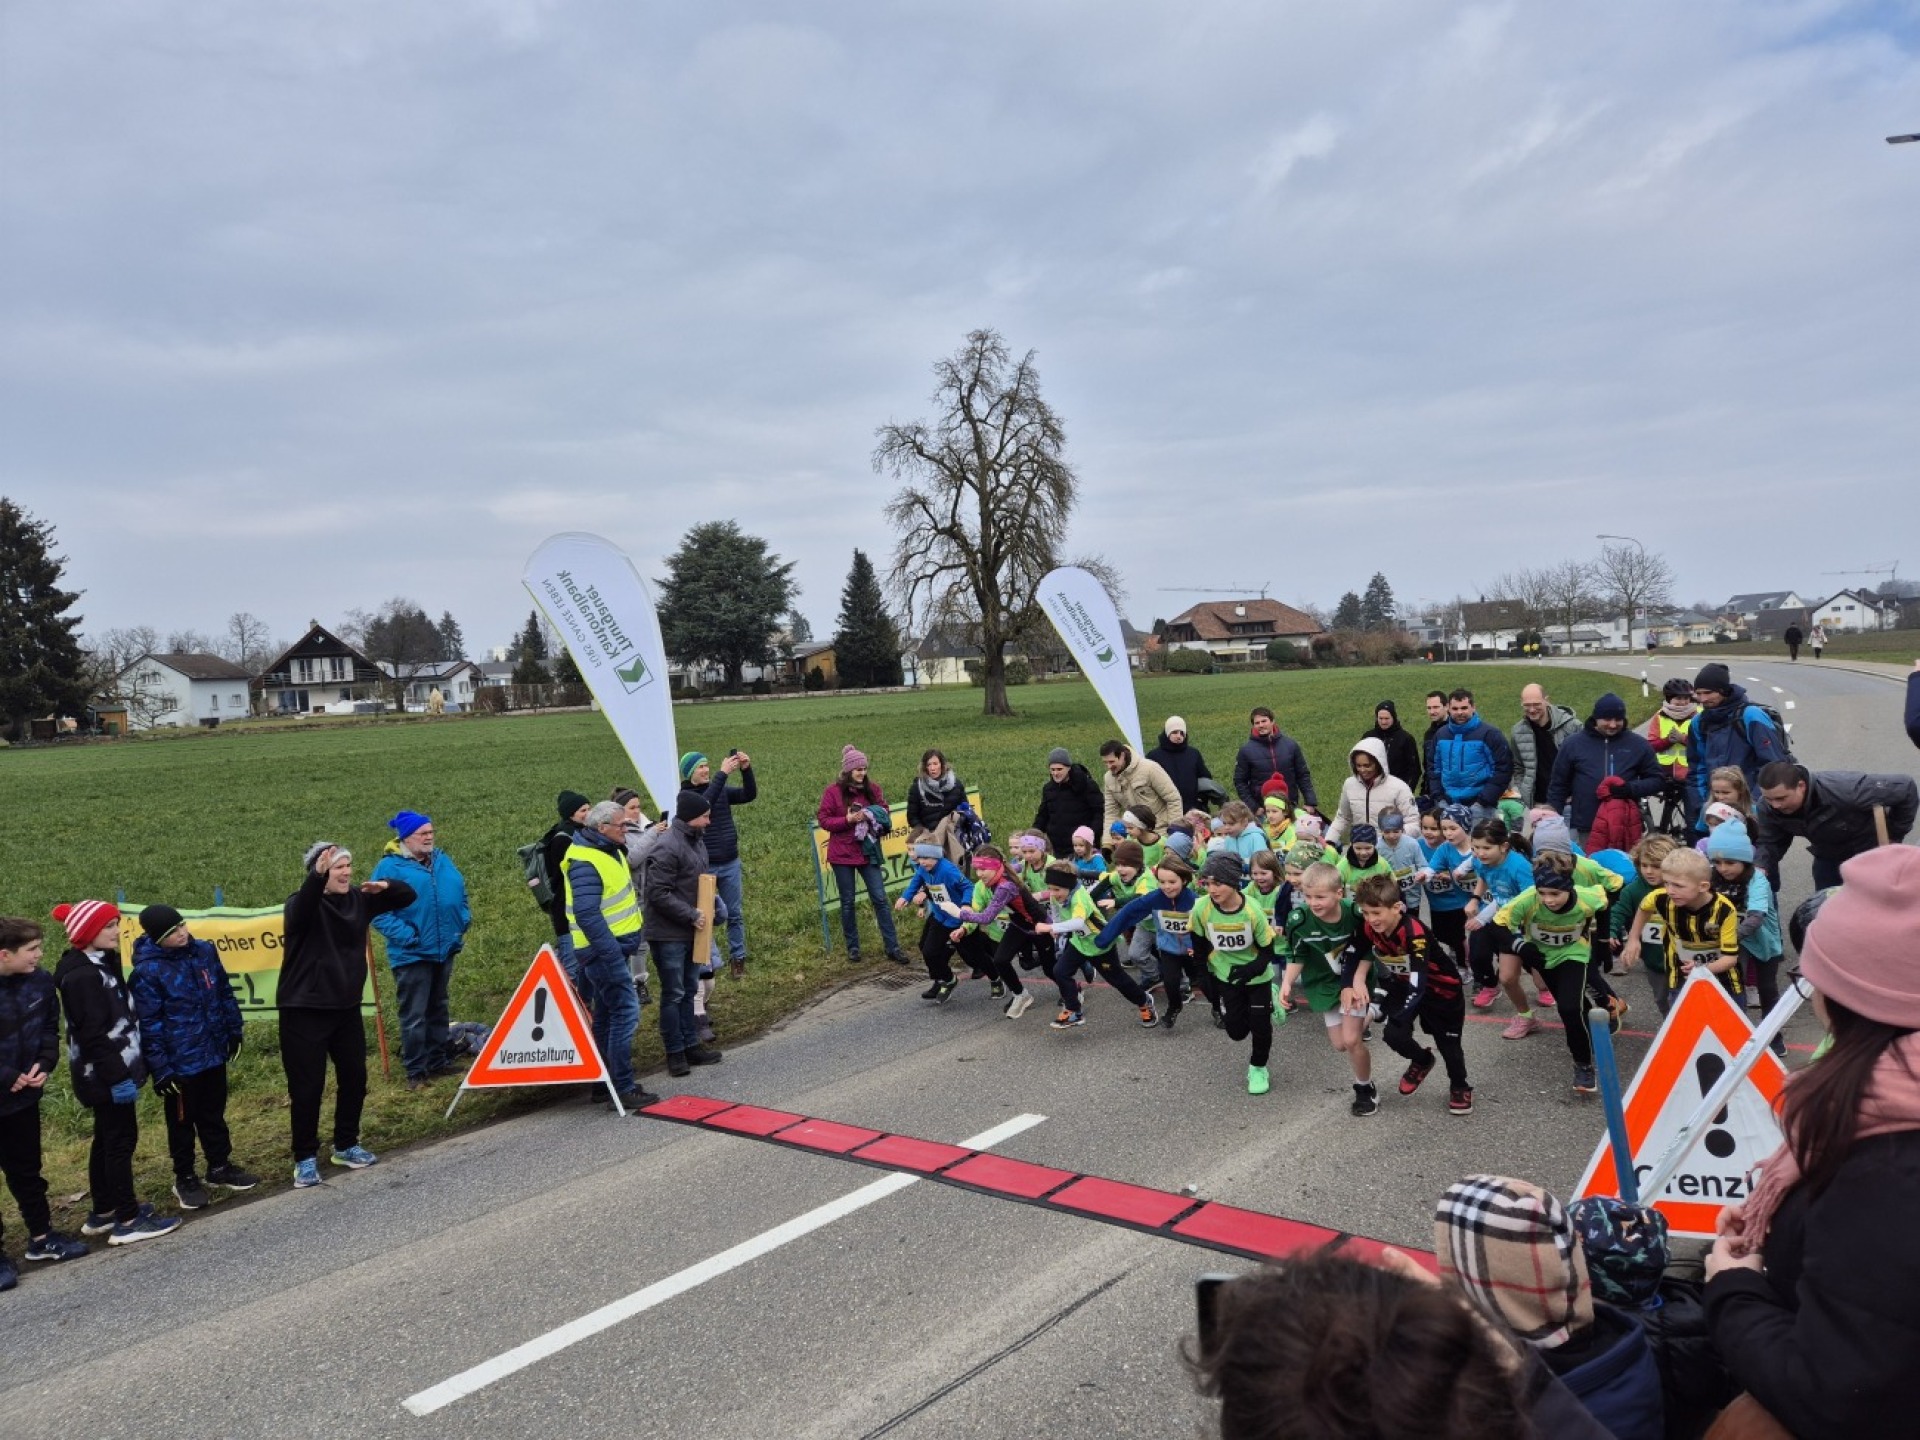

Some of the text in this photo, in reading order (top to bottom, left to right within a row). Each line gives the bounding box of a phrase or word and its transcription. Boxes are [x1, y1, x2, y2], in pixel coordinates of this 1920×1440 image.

[1217, 934, 1246, 949] 208
[1540, 932, 1574, 946] 216
[500, 1047, 575, 1064] Veranstaltung
